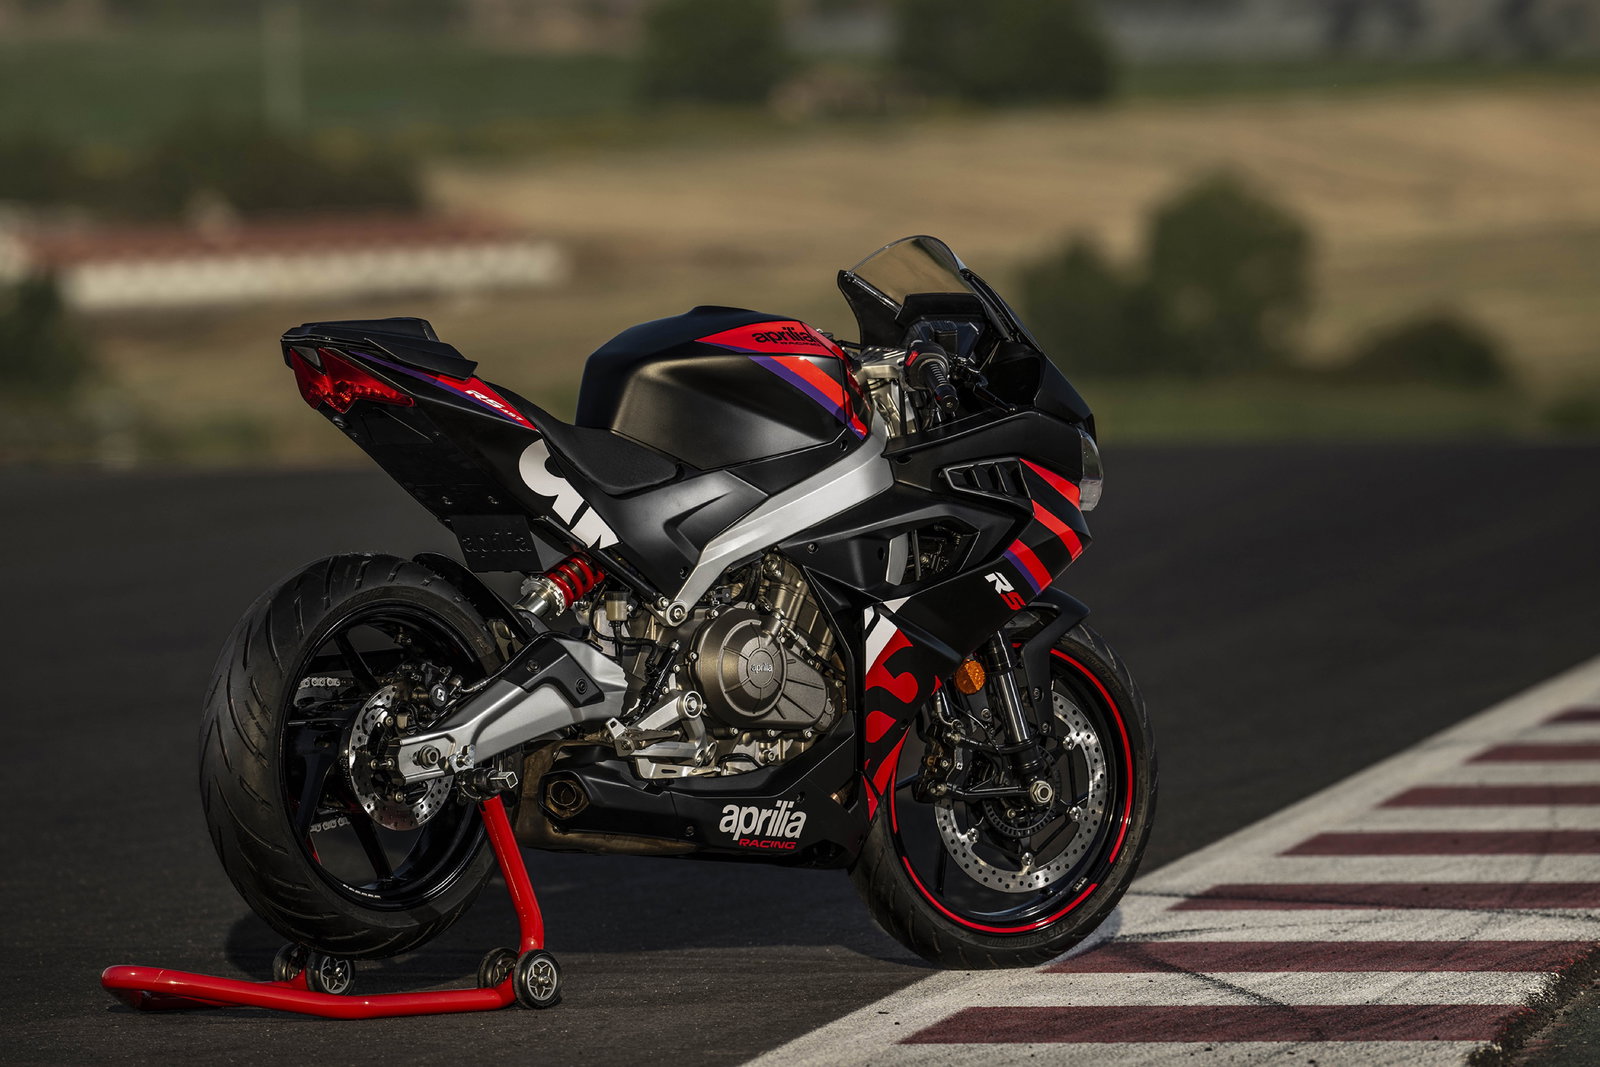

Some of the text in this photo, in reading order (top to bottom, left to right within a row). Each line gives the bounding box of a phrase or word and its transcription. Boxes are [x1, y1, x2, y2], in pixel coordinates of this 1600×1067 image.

[752, 327, 818, 344] aprilia
[464, 389, 506, 409] RS
[751, 662, 773, 674] aprilia
[719, 799, 807, 841] aprilia
[738, 838, 797, 850] RACING
